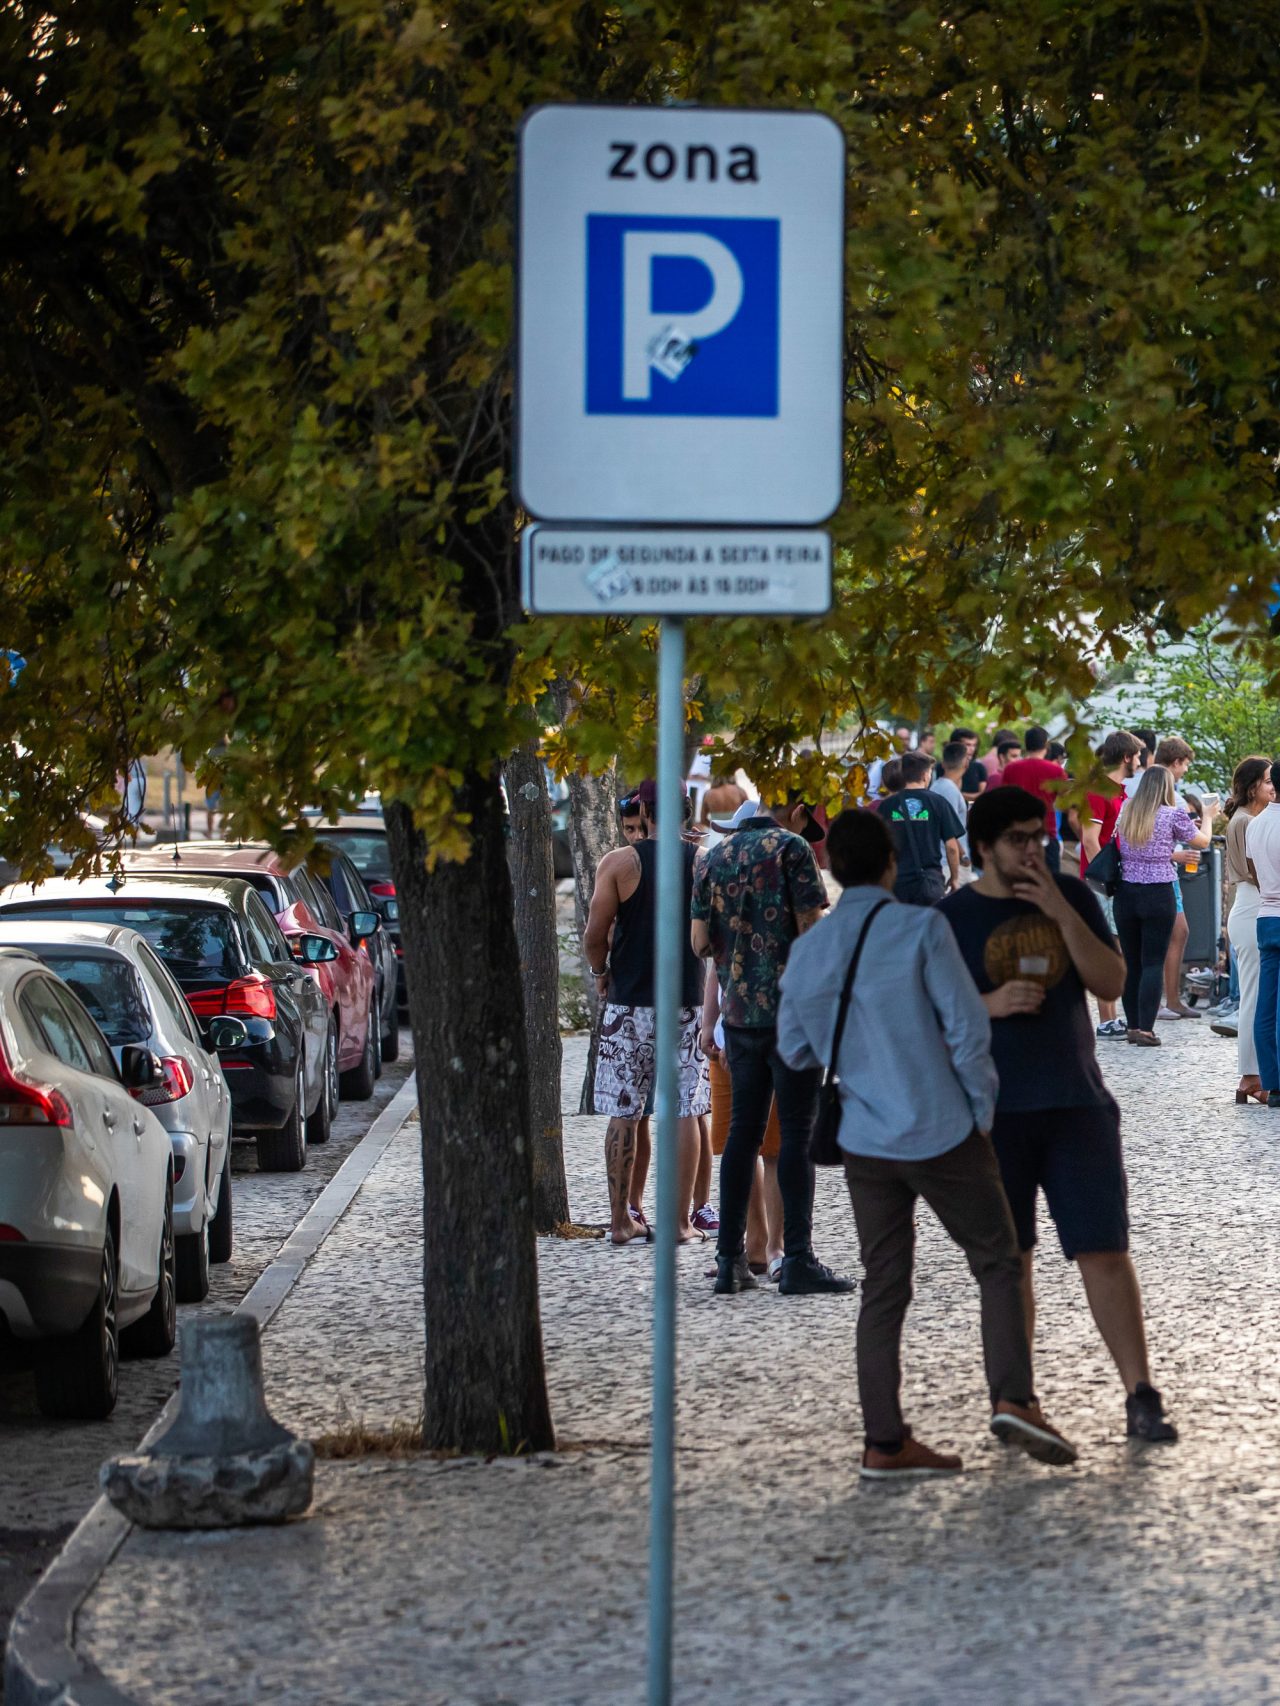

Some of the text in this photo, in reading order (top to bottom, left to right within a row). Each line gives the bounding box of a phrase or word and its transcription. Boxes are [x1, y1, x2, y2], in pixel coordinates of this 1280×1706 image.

[607, 141, 759, 183] zona
[622, 230, 744, 400] P
[538, 544, 584, 564] PAGO
[616, 544, 698, 564] SEGUNDA
[702, 544, 714, 563] A
[719, 544, 769, 564] SEXTA
[775, 544, 822, 564] FEIRA
